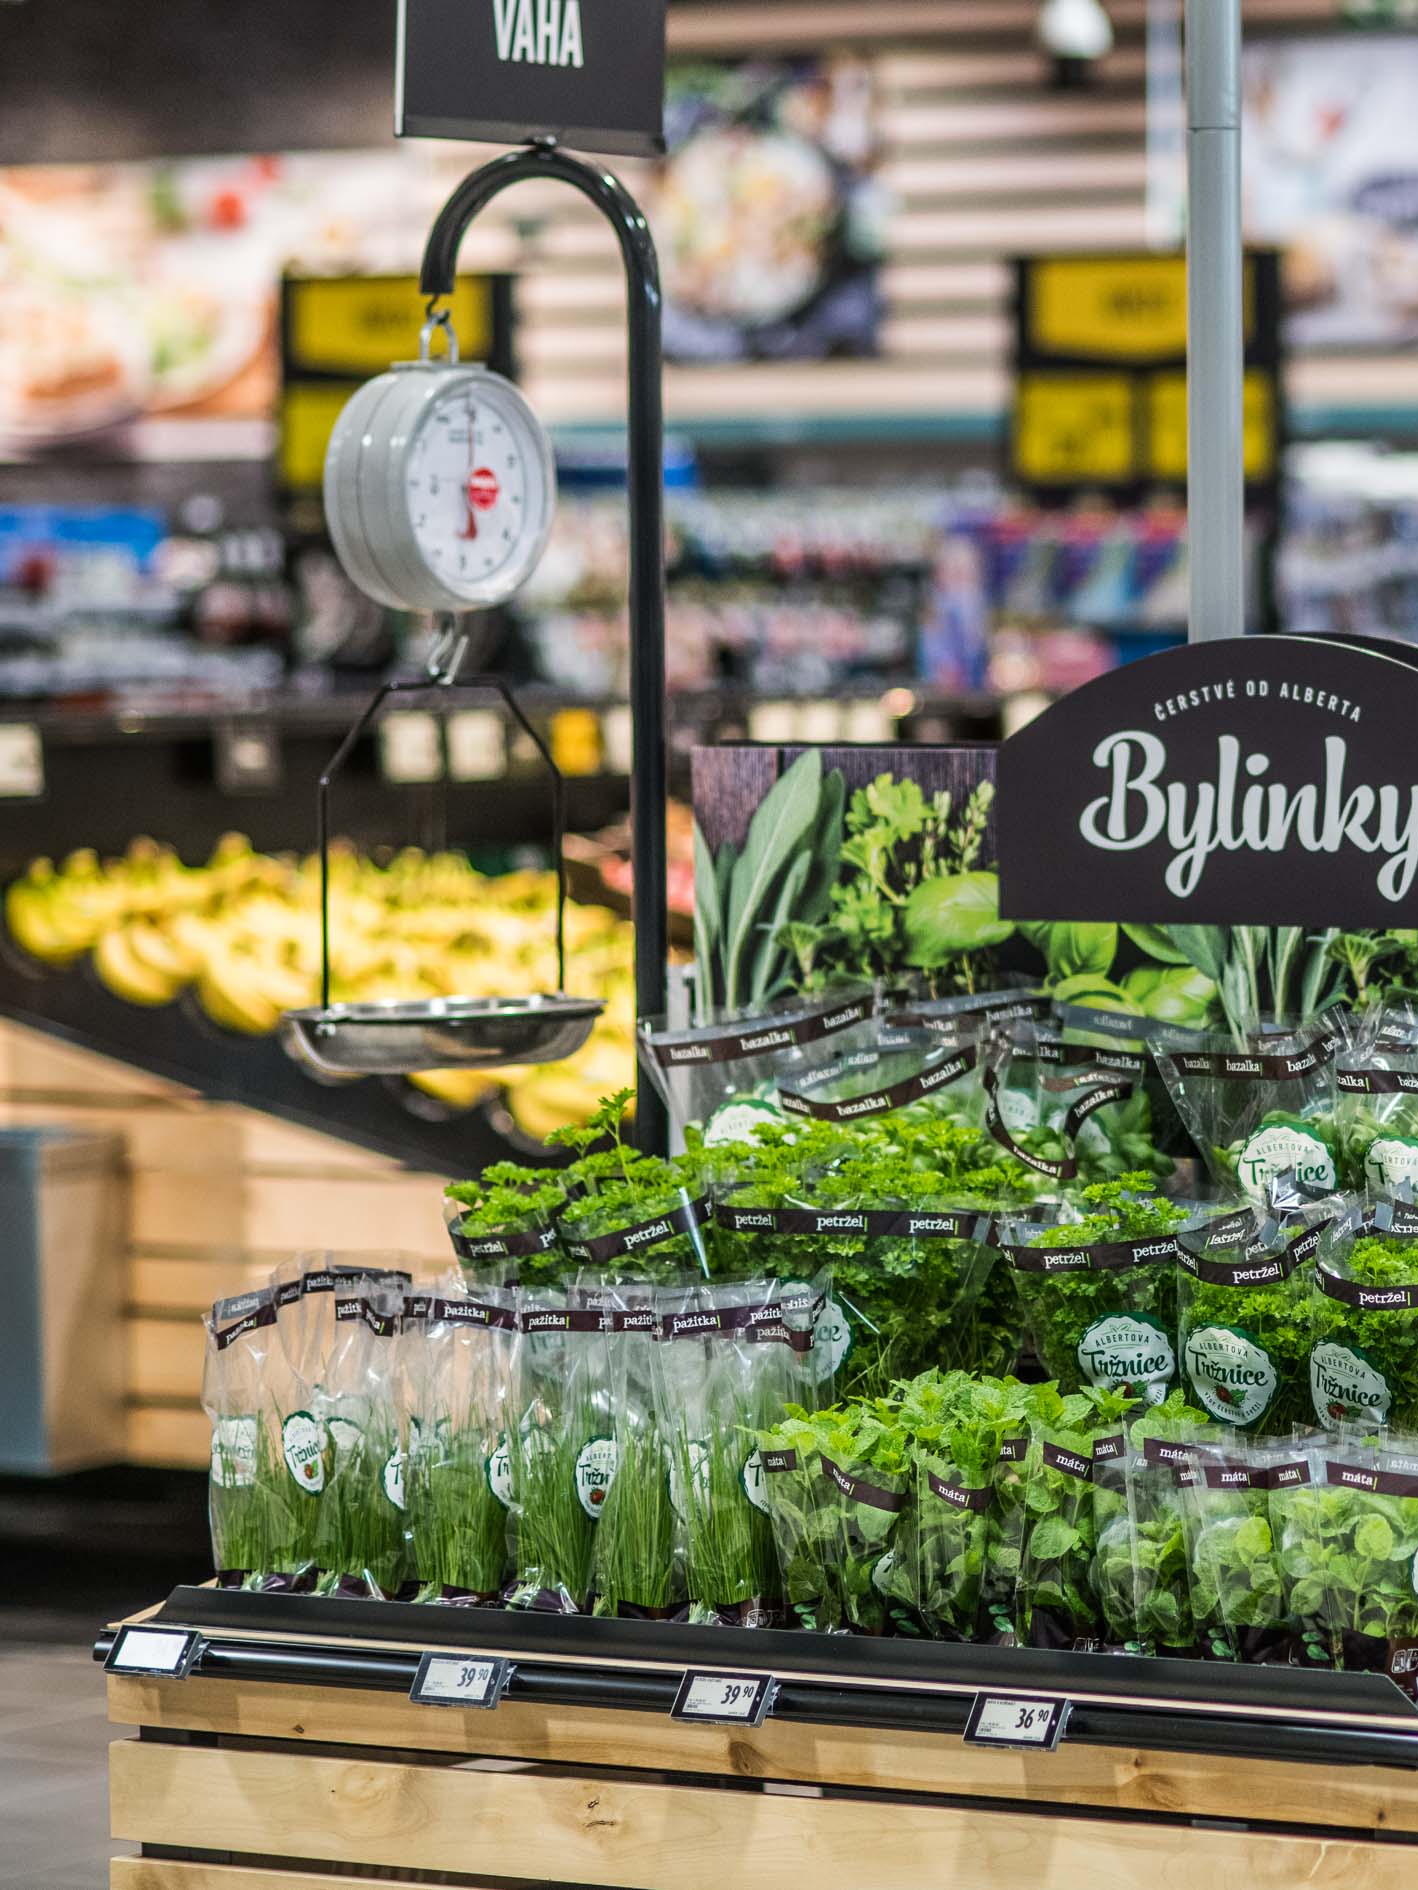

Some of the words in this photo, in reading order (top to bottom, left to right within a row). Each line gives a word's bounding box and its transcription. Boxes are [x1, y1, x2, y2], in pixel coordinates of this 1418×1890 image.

[1154, 679, 1237, 723] ČERSTVÉ
[1245, 681, 1270, 698] OD
[1279, 681, 1362, 723] ALBERTA
[823, 1007, 861, 1029] bazalka
[670, 1047, 708, 1061] bazalka
[740, 1030, 790, 1052] bazalka
[1096, 1051, 1141, 1070] bazalka
[1226, 1060, 1260, 1073] bazalka
[836, 1095, 887, 1118] bazalka
[919, 1060, 962, 1090] bazalka
[1337, 1075, 1365, 1089] zalka
[1075, 1088, 1115, 1119] bazalka
[1013, 1145, 1058, 1176] bazalka
[735, 1213, 773, 1229] petržel
[816, 1215, 864, 1232] petržel
[909, 1218, 954, 1234] petržel
[624, 1221, 670, 1250] petržel
[470, 1242, 505, 1257] petržel
[1043, 1252, 1087, 1269] petržel
[1132, 1240, 1178, 1262] petržel
[1232, 1262, 1281, 1284] petržel
[1292, 1232, 1321, 1263] petržel
[1359, 1291, 1407, 1305] petržel
[444, 1305, 486, 1319] pažitka
[528, 1314, 566, 1330] pažitka
[673, 1314, 717, 1333] pažitka
[1095, 1333, 1149, 1348] ALBERTOVA
[1199, 1342, 1248, 1358] ALBERTOVA
[1081, 1349, 1168, 1378] Tržnice
[1187, 1346, 1269, 1387] Tržnice
[1321, 1355, 1366, 1380] ALBERTOVA
[1312, 1356, 1384, 1407] Tržnice
[1096, 1441, 1115, 1456] máta
[1056, 1453, 1086, 1474] máta
[832, 1468, 852, 1491] máta
[1221, 1470, 1248, 1482] máta
[1278, 1469, 1298, 1482] máta
[1342, 1469, 1373, 1486] máta
[939, 1482, 967, 1503] máta
[457, 1667, 477, 1688] 39
[720, 1684, 741, 1705] 39
[742, 1686, 755, 1698] 90
[1015, 1708, 1036, 1729] 36
[1037, 1709, 1050, 1722] 90
